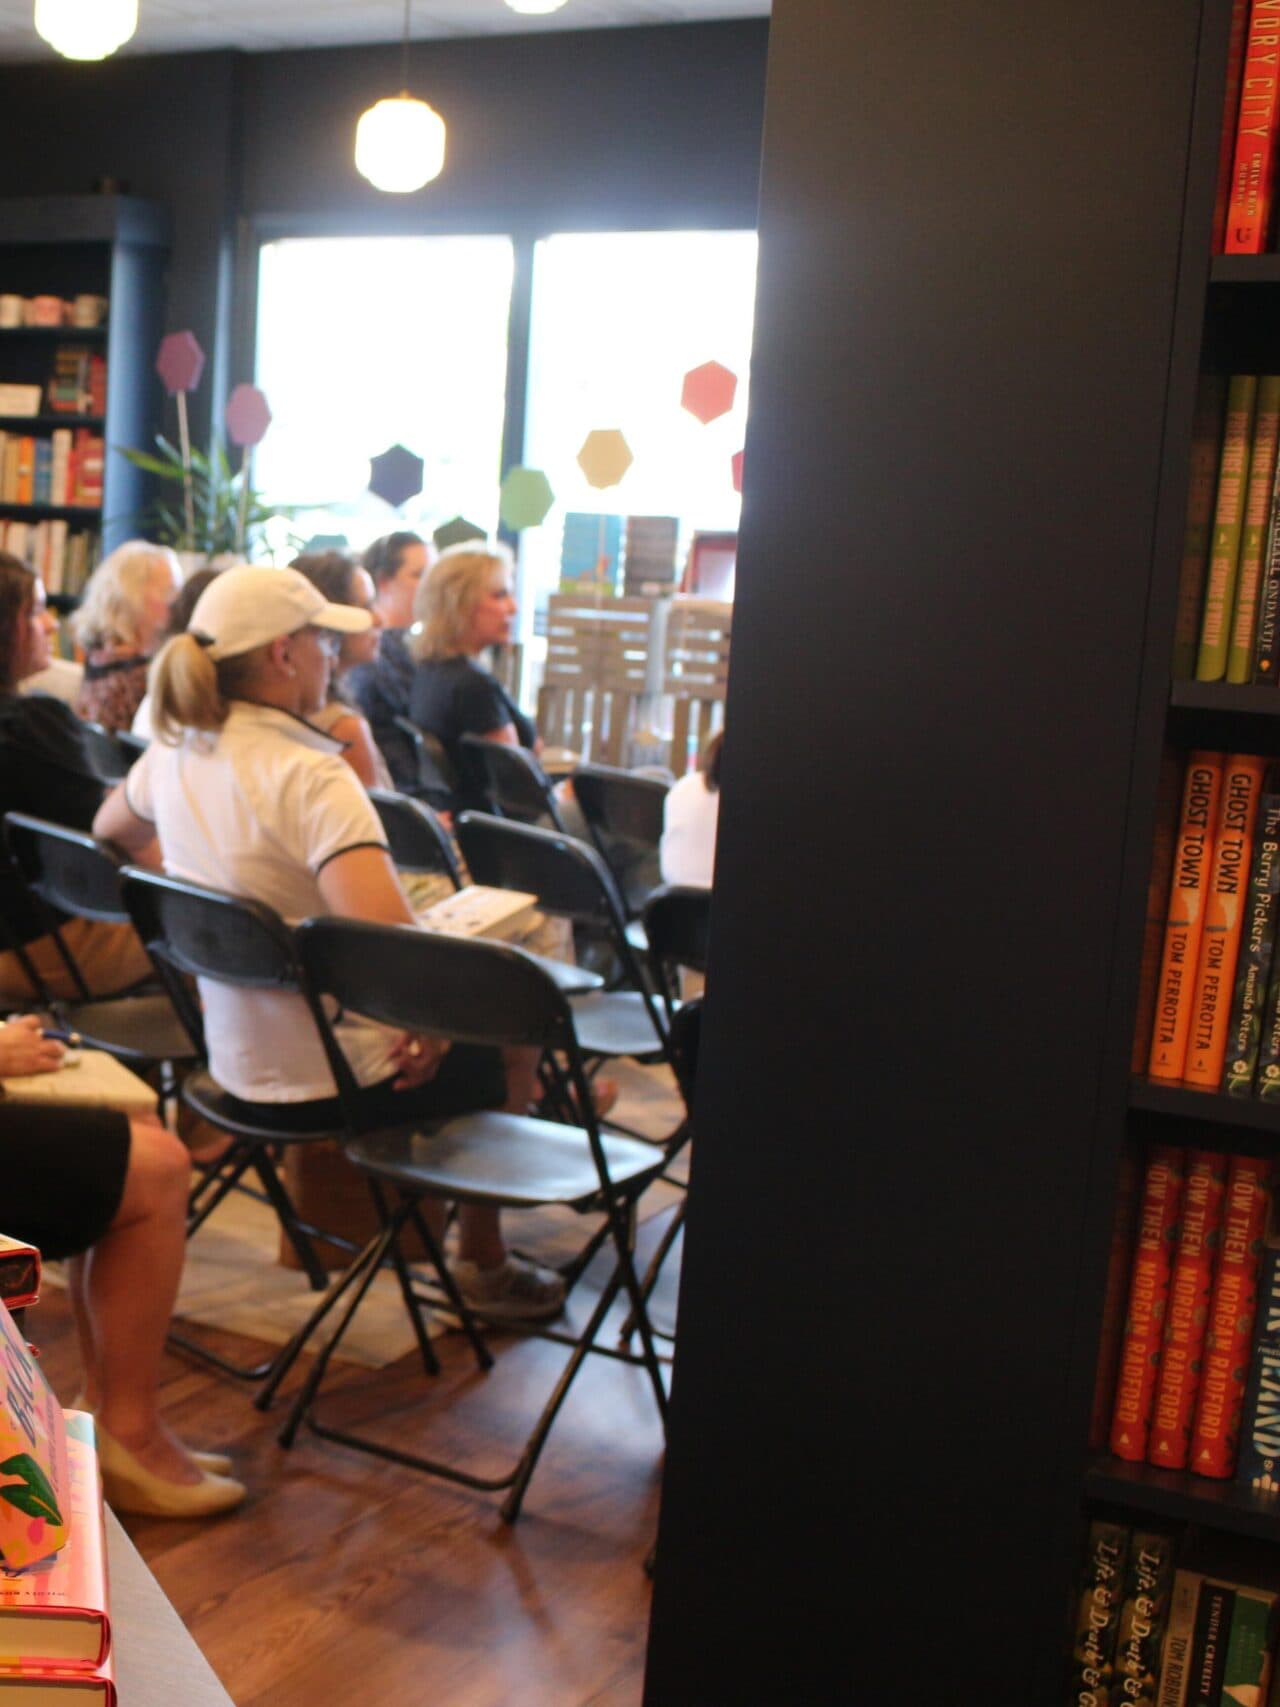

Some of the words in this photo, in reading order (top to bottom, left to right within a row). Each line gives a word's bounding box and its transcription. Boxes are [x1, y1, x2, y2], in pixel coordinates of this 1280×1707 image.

[1241, 78, 1274, 137] CITY
[1261, 579, 1279, 653] ONDAATJE
[1187, 768, 1213, 829] GHOST
[1224, 772, 1252, 833] GHOST
[1179, 834, 1204, 889] TOWN
[1216, 838, 1243, 895] TOWN
[1255, 842, 1278, 888] Berry
[1169, 932, 1187, 962] TOM
[1250, 893, 1271, 953] Pickers
[1207, 937, 1225, 968] TOM
[1160, 969, 1183, 1044] PERROTTA
[1197, 974, 1221, 1051] PERROTTA
[1241, 964, 1260, 1011] Amanda
[1237, 1011, 1254, 1052] Peters
[1233, 1169, 1258, 1212] NOW
[1140, 1205, 1165, 1251] THEN
[1181, 1209, 1206, 1257] THEN
[1224, 1216, 1250, 1265] THEN
[1130, 1261, 1157, 1337] MORGAN
[1172, 1265, 1198, 1343] MORGAN
[1215, 1273, 1241, 1350] MORGAN
[1119, 1341, 1146, 1424] RADFORD
[1157, 1348, 1187, 1431] RADFORD
[1199, 1355, 1229, 1440] RADFORD
[1094, 1587, 1112, 1607] &
[1135, 1597, 1153, 1617] &
[1169, 1637, 1187, 1660] TOM
[1200, 1645, 1215, 1696] CRUELTY
[1082, 1668, 1100, 1688] &
[1123, 1677, 1143, 1698] &
